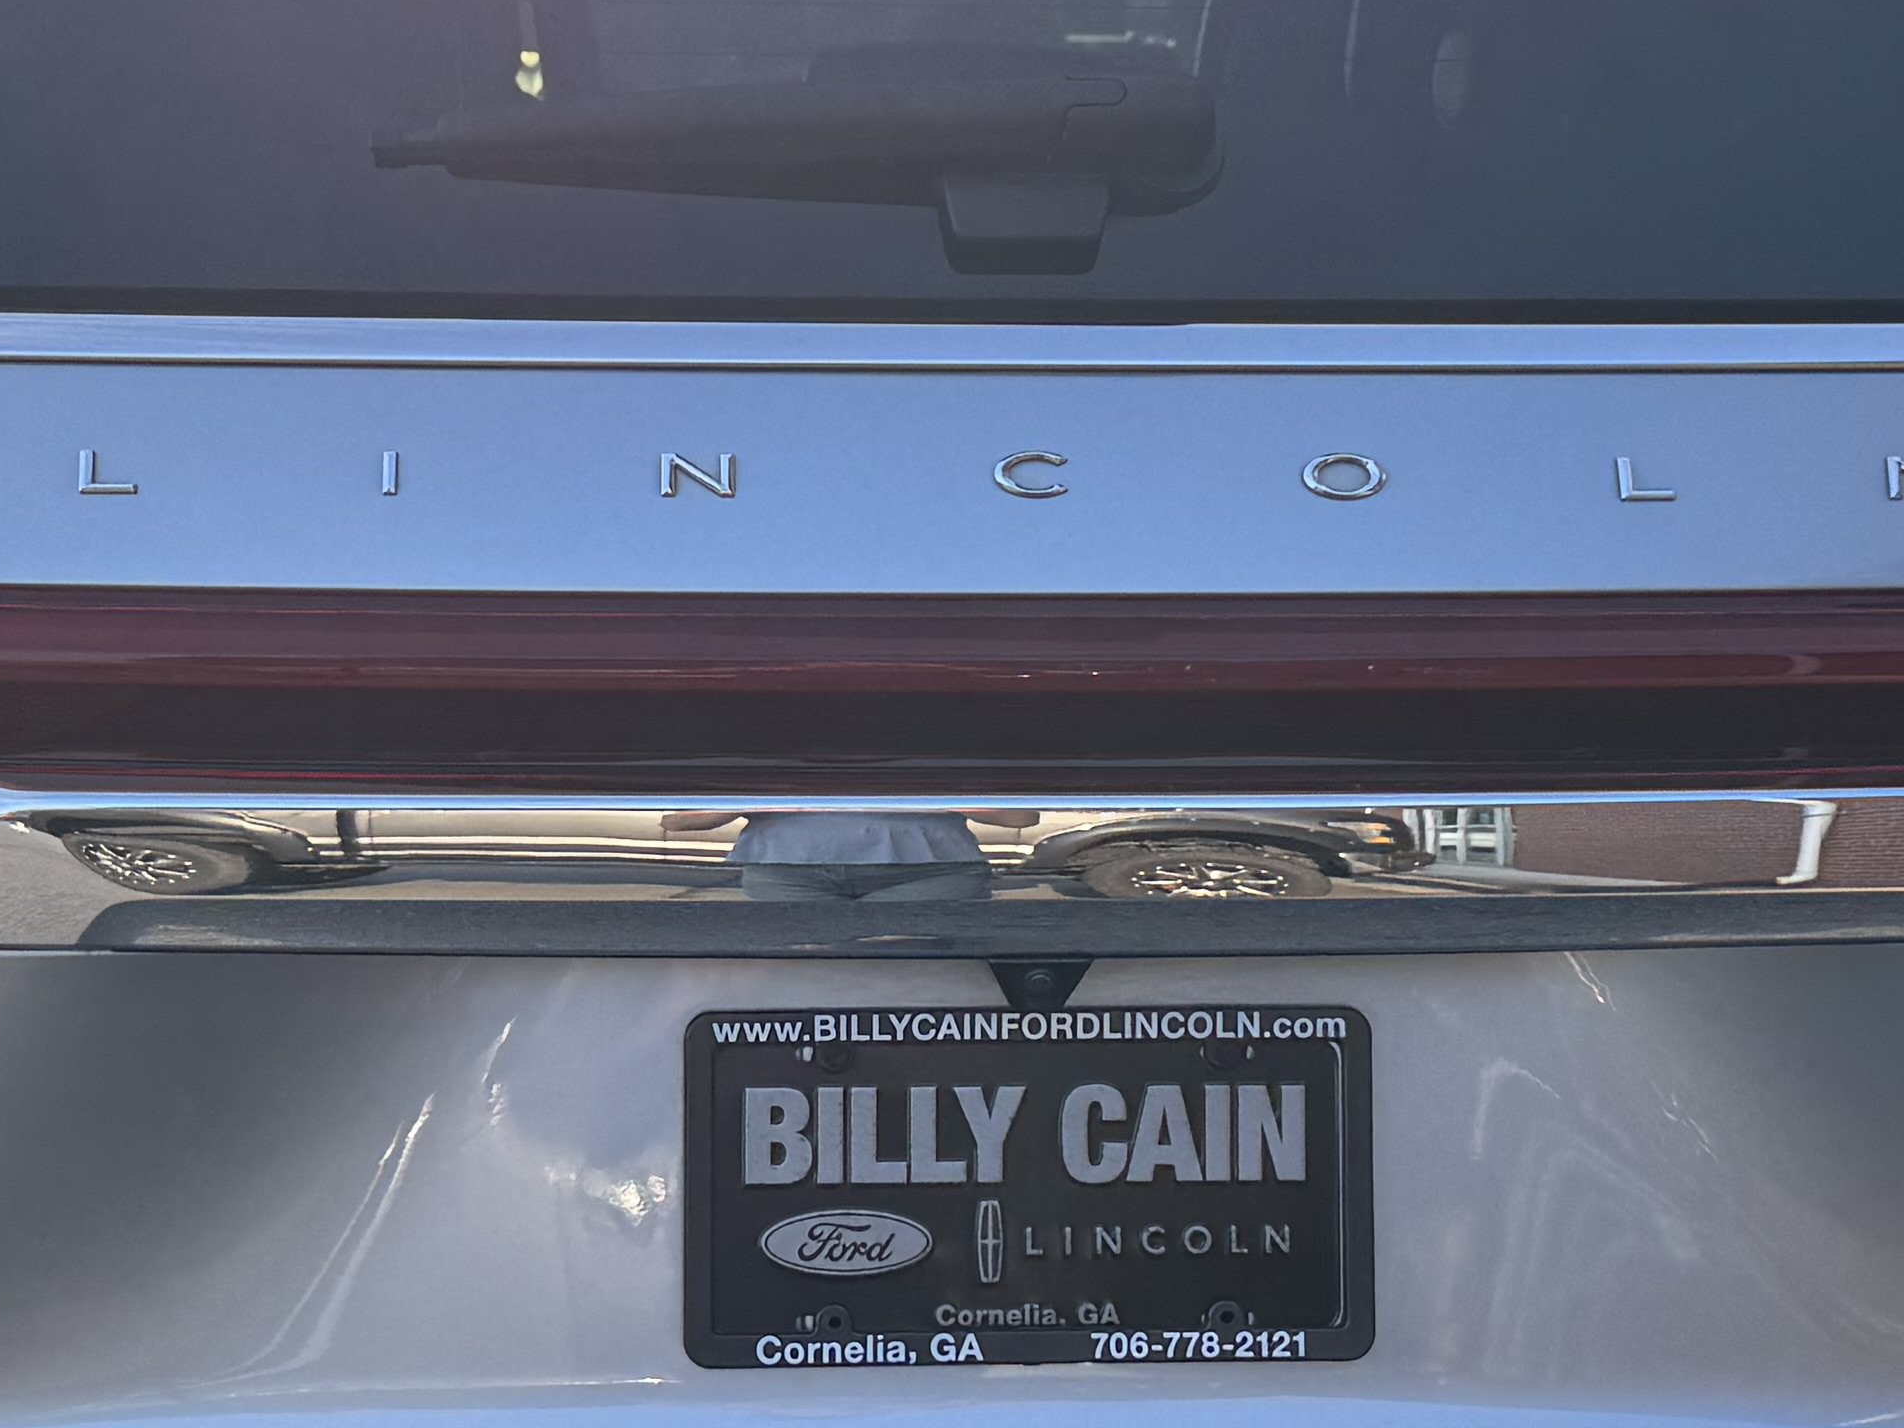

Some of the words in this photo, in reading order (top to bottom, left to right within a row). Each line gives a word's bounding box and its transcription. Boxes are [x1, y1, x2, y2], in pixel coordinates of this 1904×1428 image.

[712, 1011, 1347, 1043] www.BILLYCAINFORDLINCOLN.com
[743, 1084, 1026, 1185] BILLY
[1060, 1082, 1307, 1184] CAIN
[797, 1221, 895, 1263] Ford
[1024, 1224, 1292, 1256] LINCOLN
[1077, 1303, 1120, 1327] GA
[755, 1334, 918, 1366] Cornelia,
[930, 1332, 985, 1362] GA
[1090, 1330, 1308, 1360] 706-778-2121
